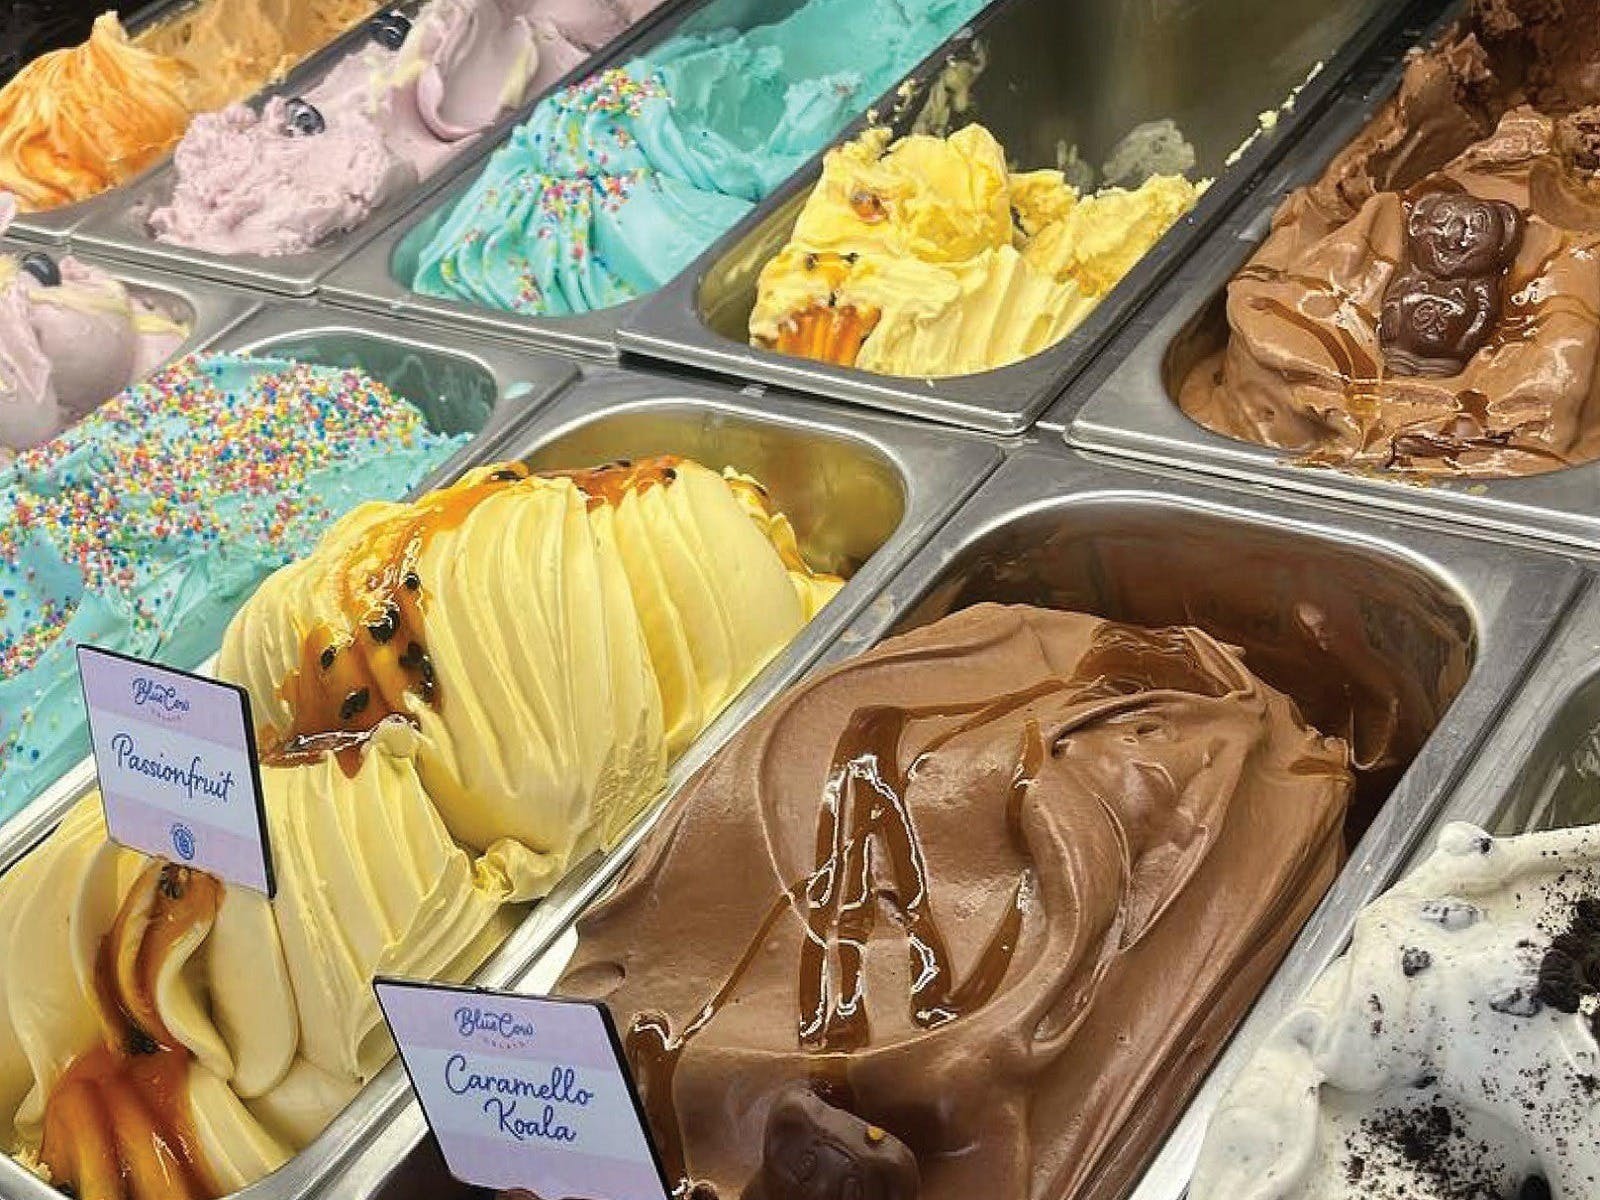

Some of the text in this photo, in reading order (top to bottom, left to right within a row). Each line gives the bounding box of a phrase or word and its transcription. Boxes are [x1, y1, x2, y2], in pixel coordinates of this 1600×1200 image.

[111, 733, 234, 801] Passionfruit
[445, 1053, 594, 1106] Caramello
[483, 1096, 577, 1141] Koala
